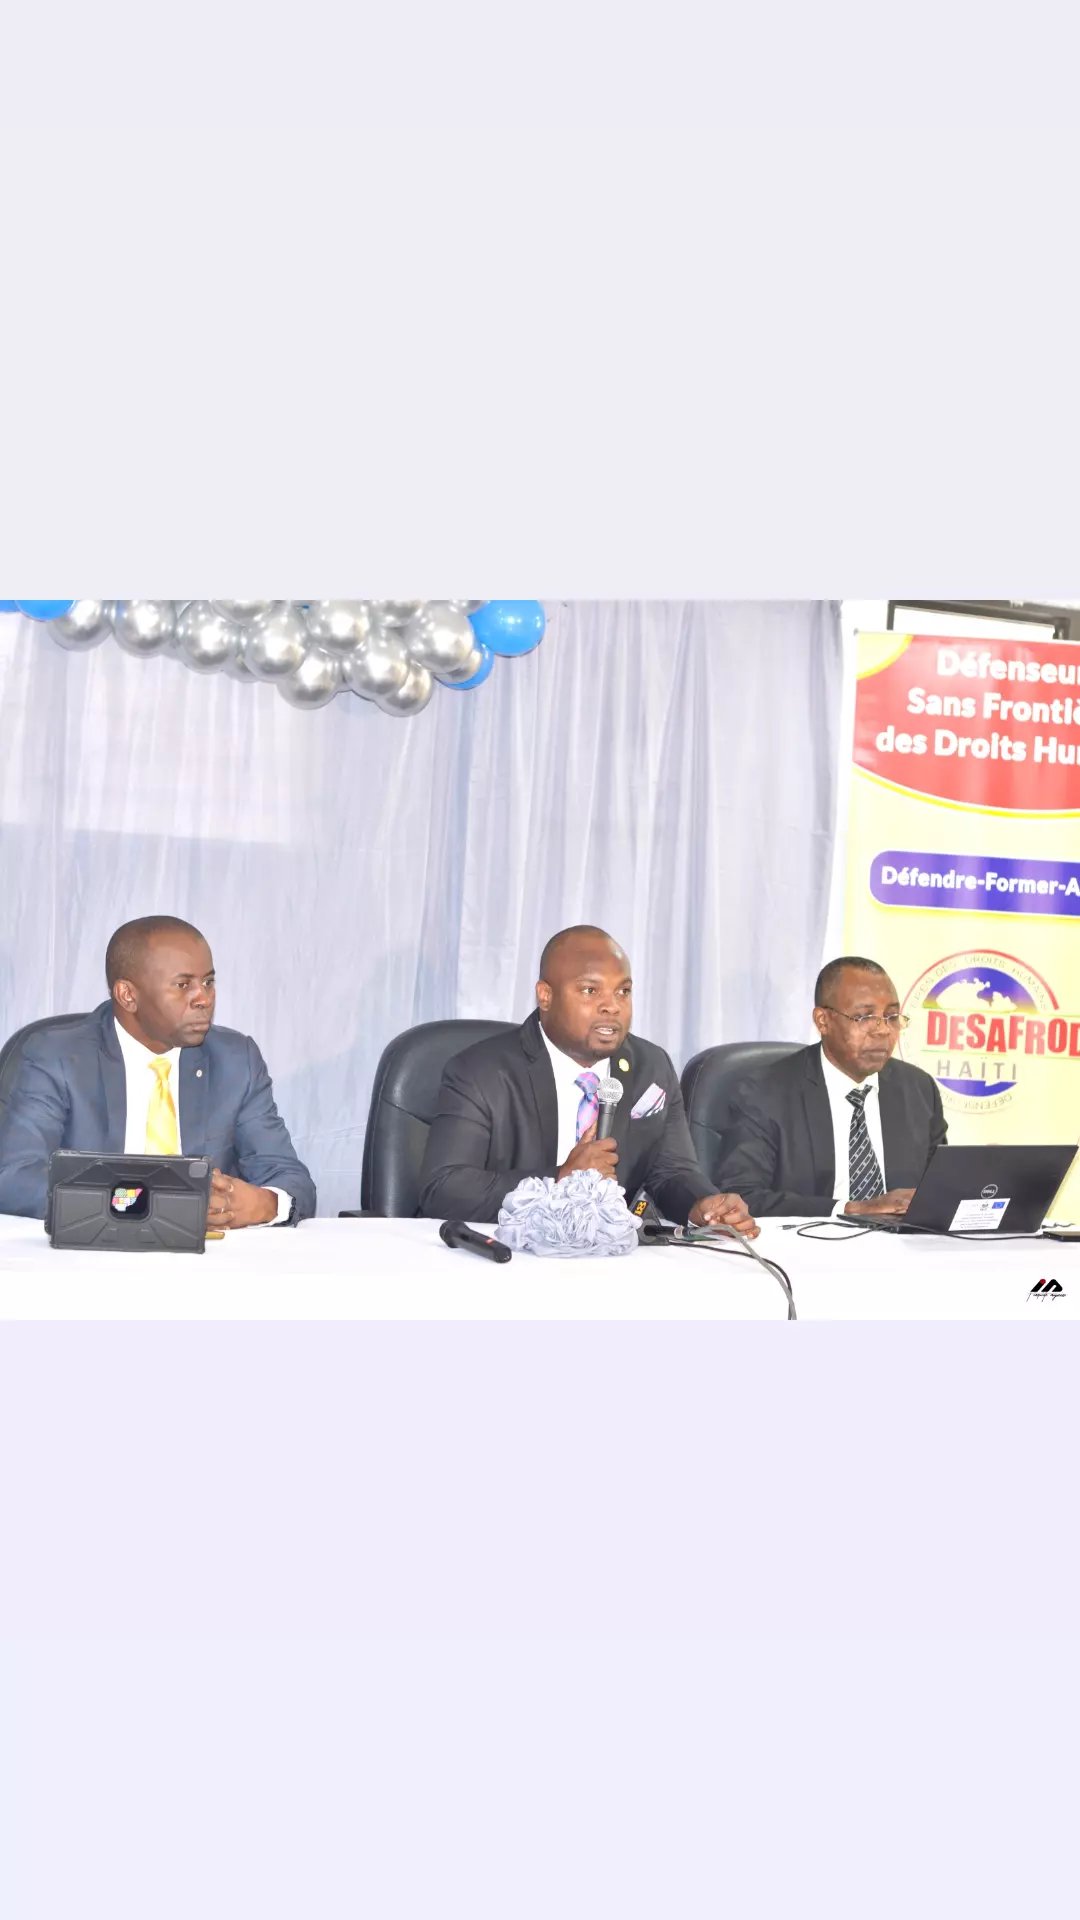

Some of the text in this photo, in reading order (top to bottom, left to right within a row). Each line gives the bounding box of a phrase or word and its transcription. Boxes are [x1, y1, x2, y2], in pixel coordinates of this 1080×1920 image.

[936, 649, 1080, 686] Défenseu
[906, 687, 976, 718] Sans
[875, 725, 1080, 766] des Droits Hu
[881, 865, 1080, 897] Défendre-Former-A
